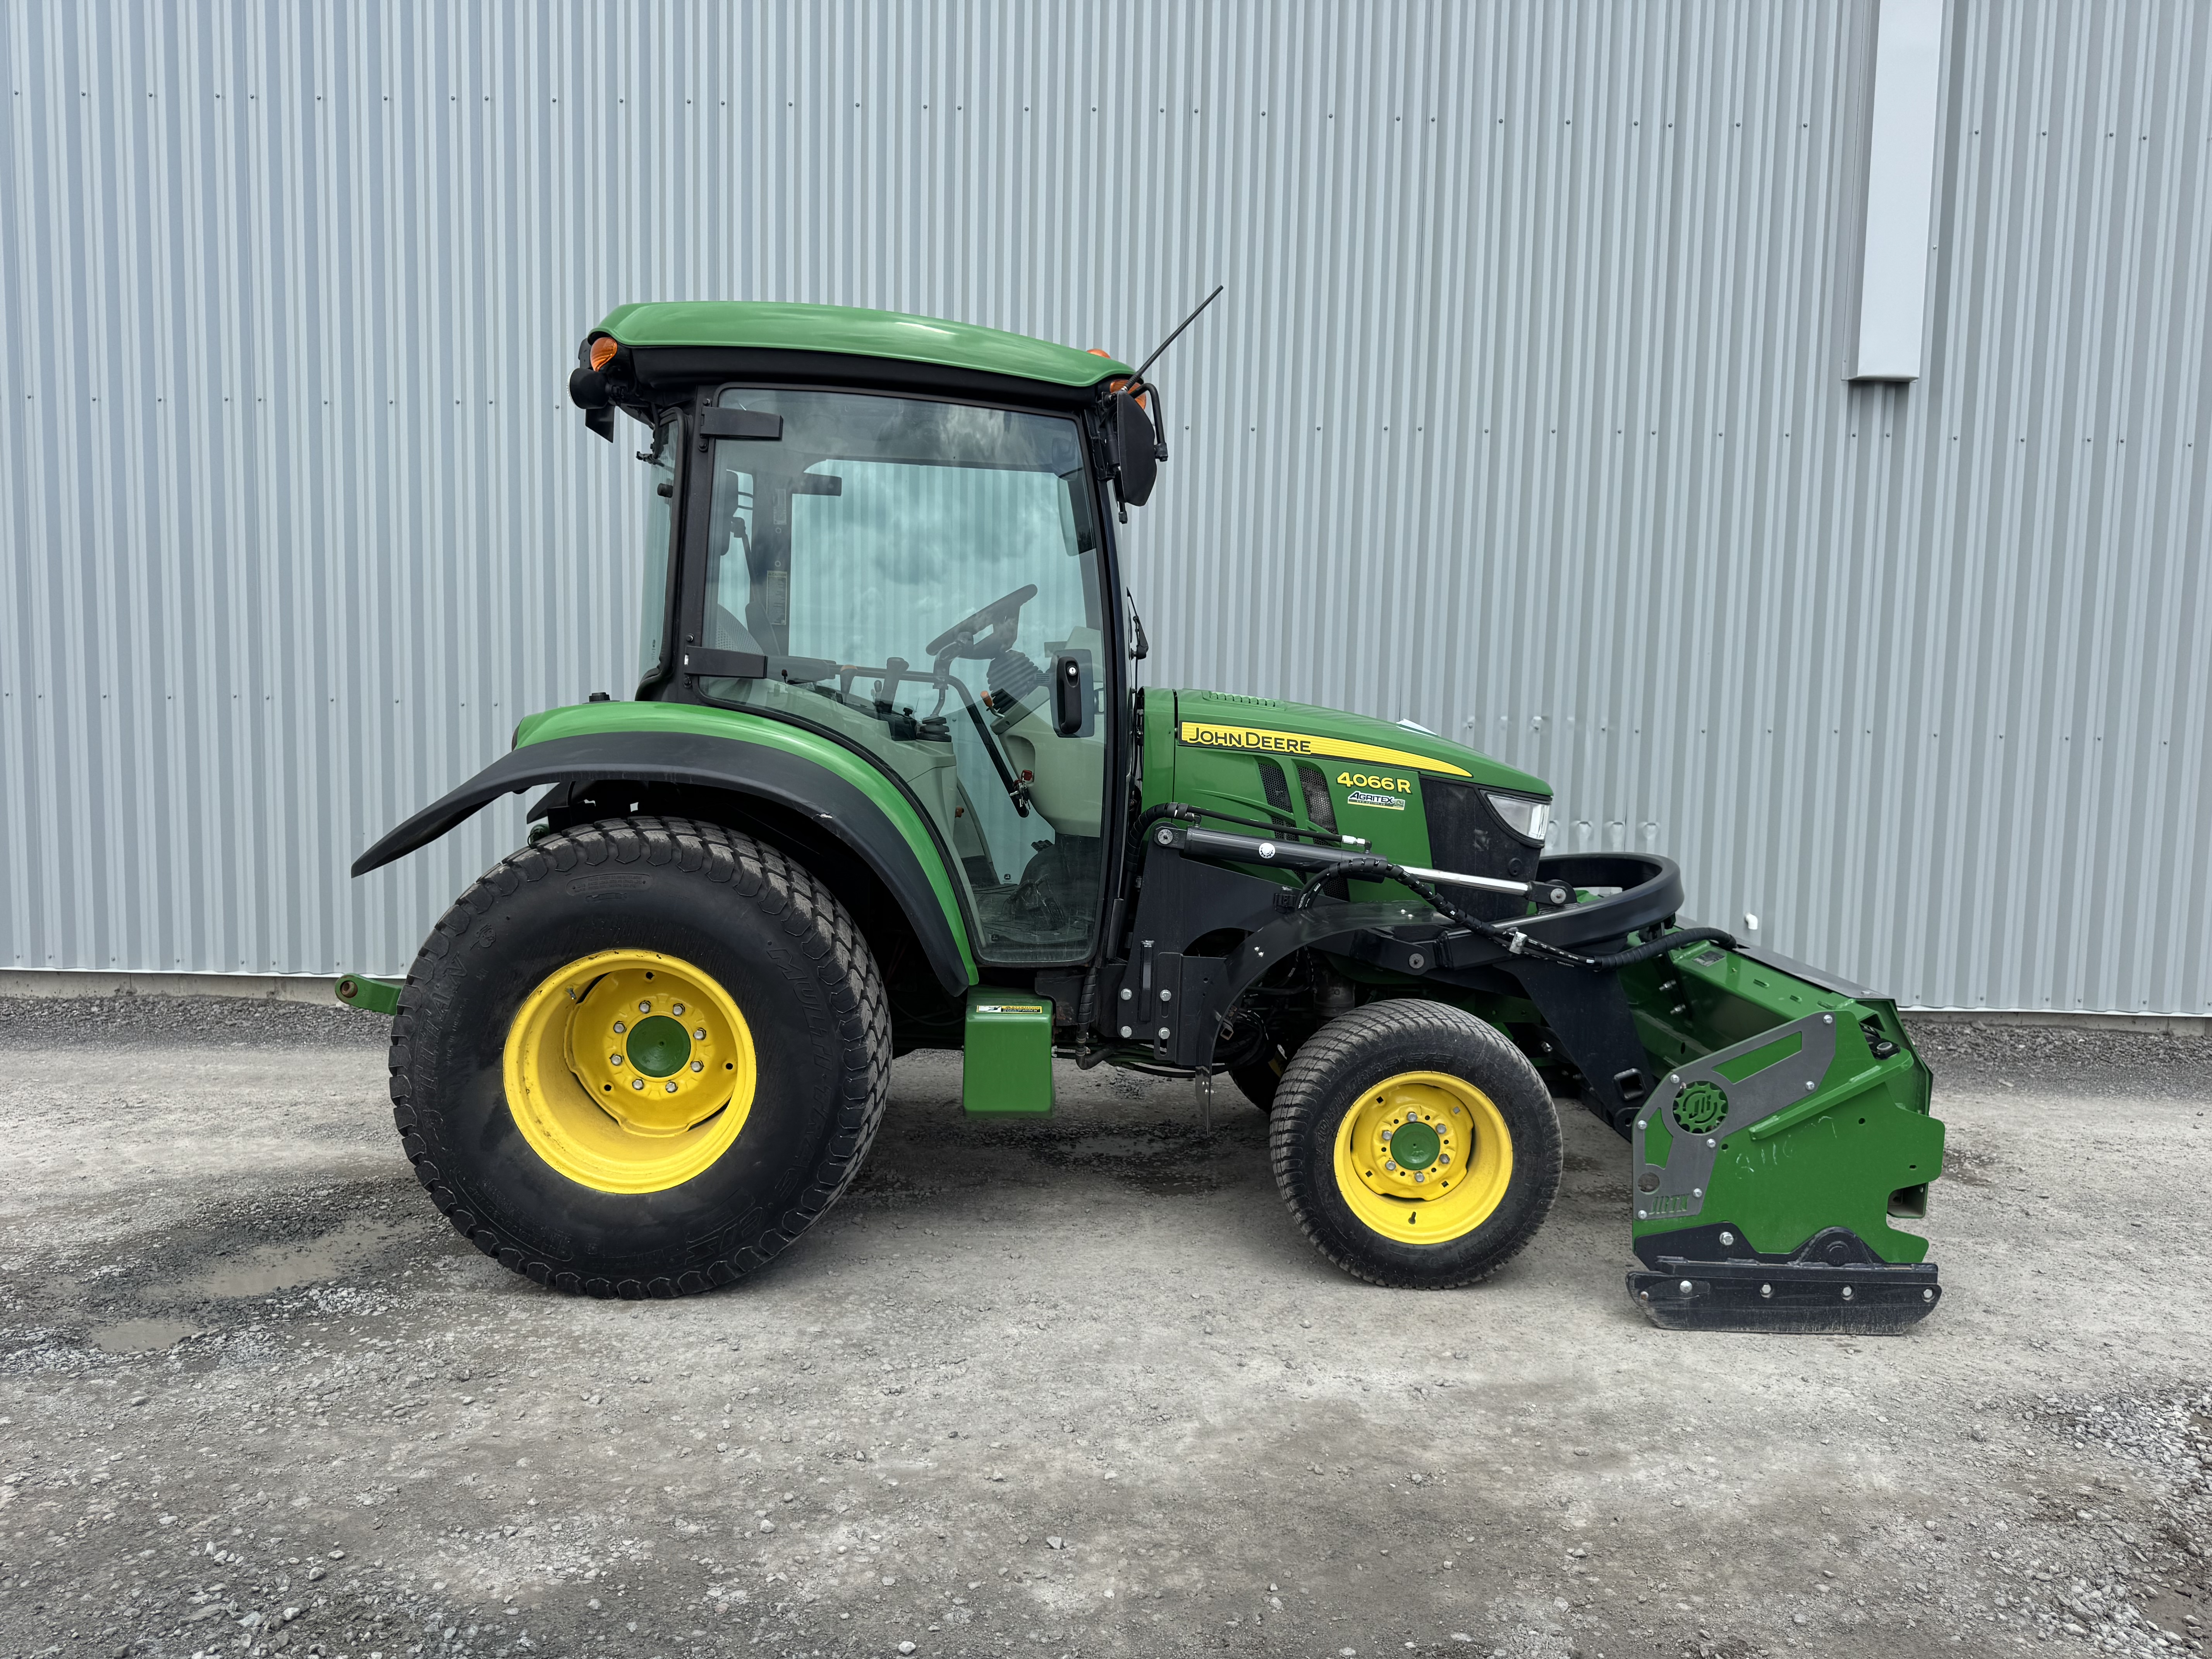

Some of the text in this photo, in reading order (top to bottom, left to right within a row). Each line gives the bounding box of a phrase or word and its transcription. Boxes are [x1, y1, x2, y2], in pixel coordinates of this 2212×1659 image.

[1189, 727, 1311, 752] JOHN DEERE
[1337, 772, 1412, 793] 4066 R
[1350, 792, 1393, 803] AGRITEX
